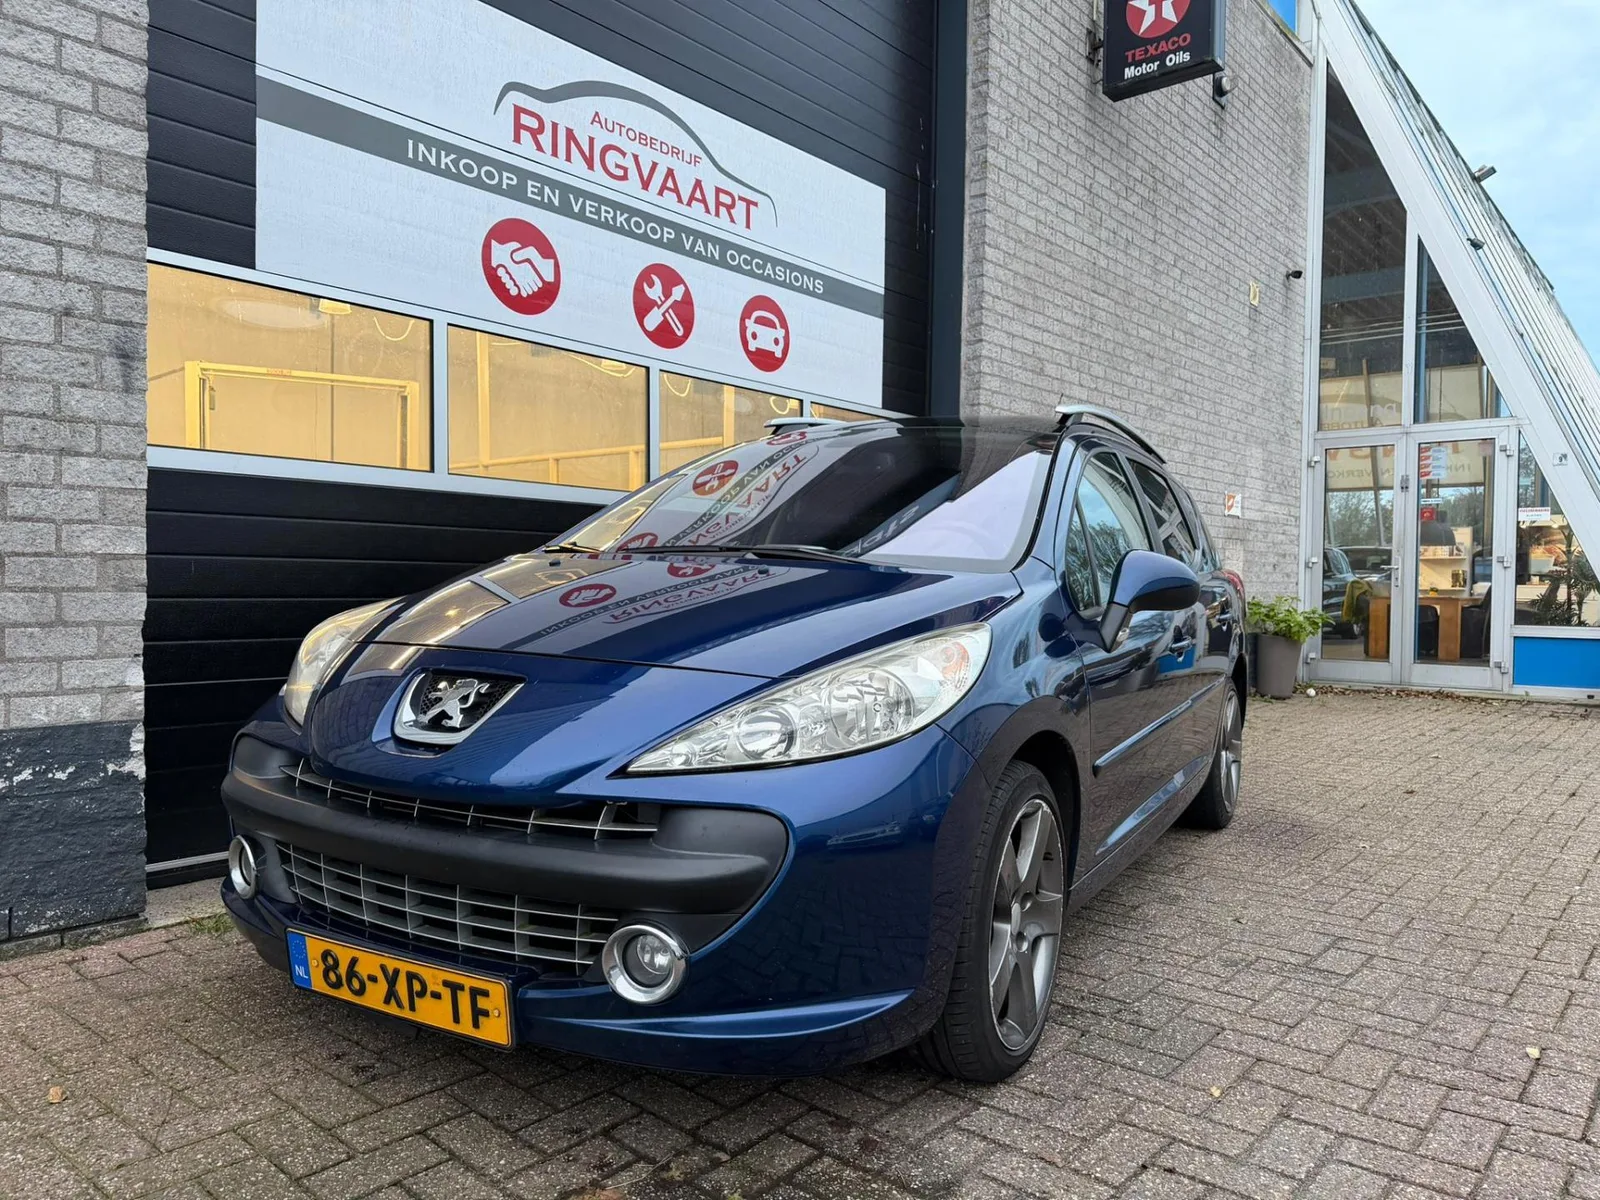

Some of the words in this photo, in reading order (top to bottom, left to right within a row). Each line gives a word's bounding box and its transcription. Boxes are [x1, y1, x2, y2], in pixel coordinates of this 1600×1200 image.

[1124, 60, 1160, 80] Motor
[1165, 51, 1191, 67] Oils
[1125, 33, 1191, 63] TEXACO
[512, 104, 759, 230] RINGVAART
[590, 112, 702, 167] AUTOBEDRIJF
[407, 139, 518, 190] INKOOP
[527, 180, 559, 207] EN
[569, 198, 675, 244] VERKOOP
[681, 234, 720, 260] VAN
[726, 249, 824, 294] OCCASIONS
[295, 965, 308, 979] NL
[320, 949, 490, 1029] 86-XP-TF
